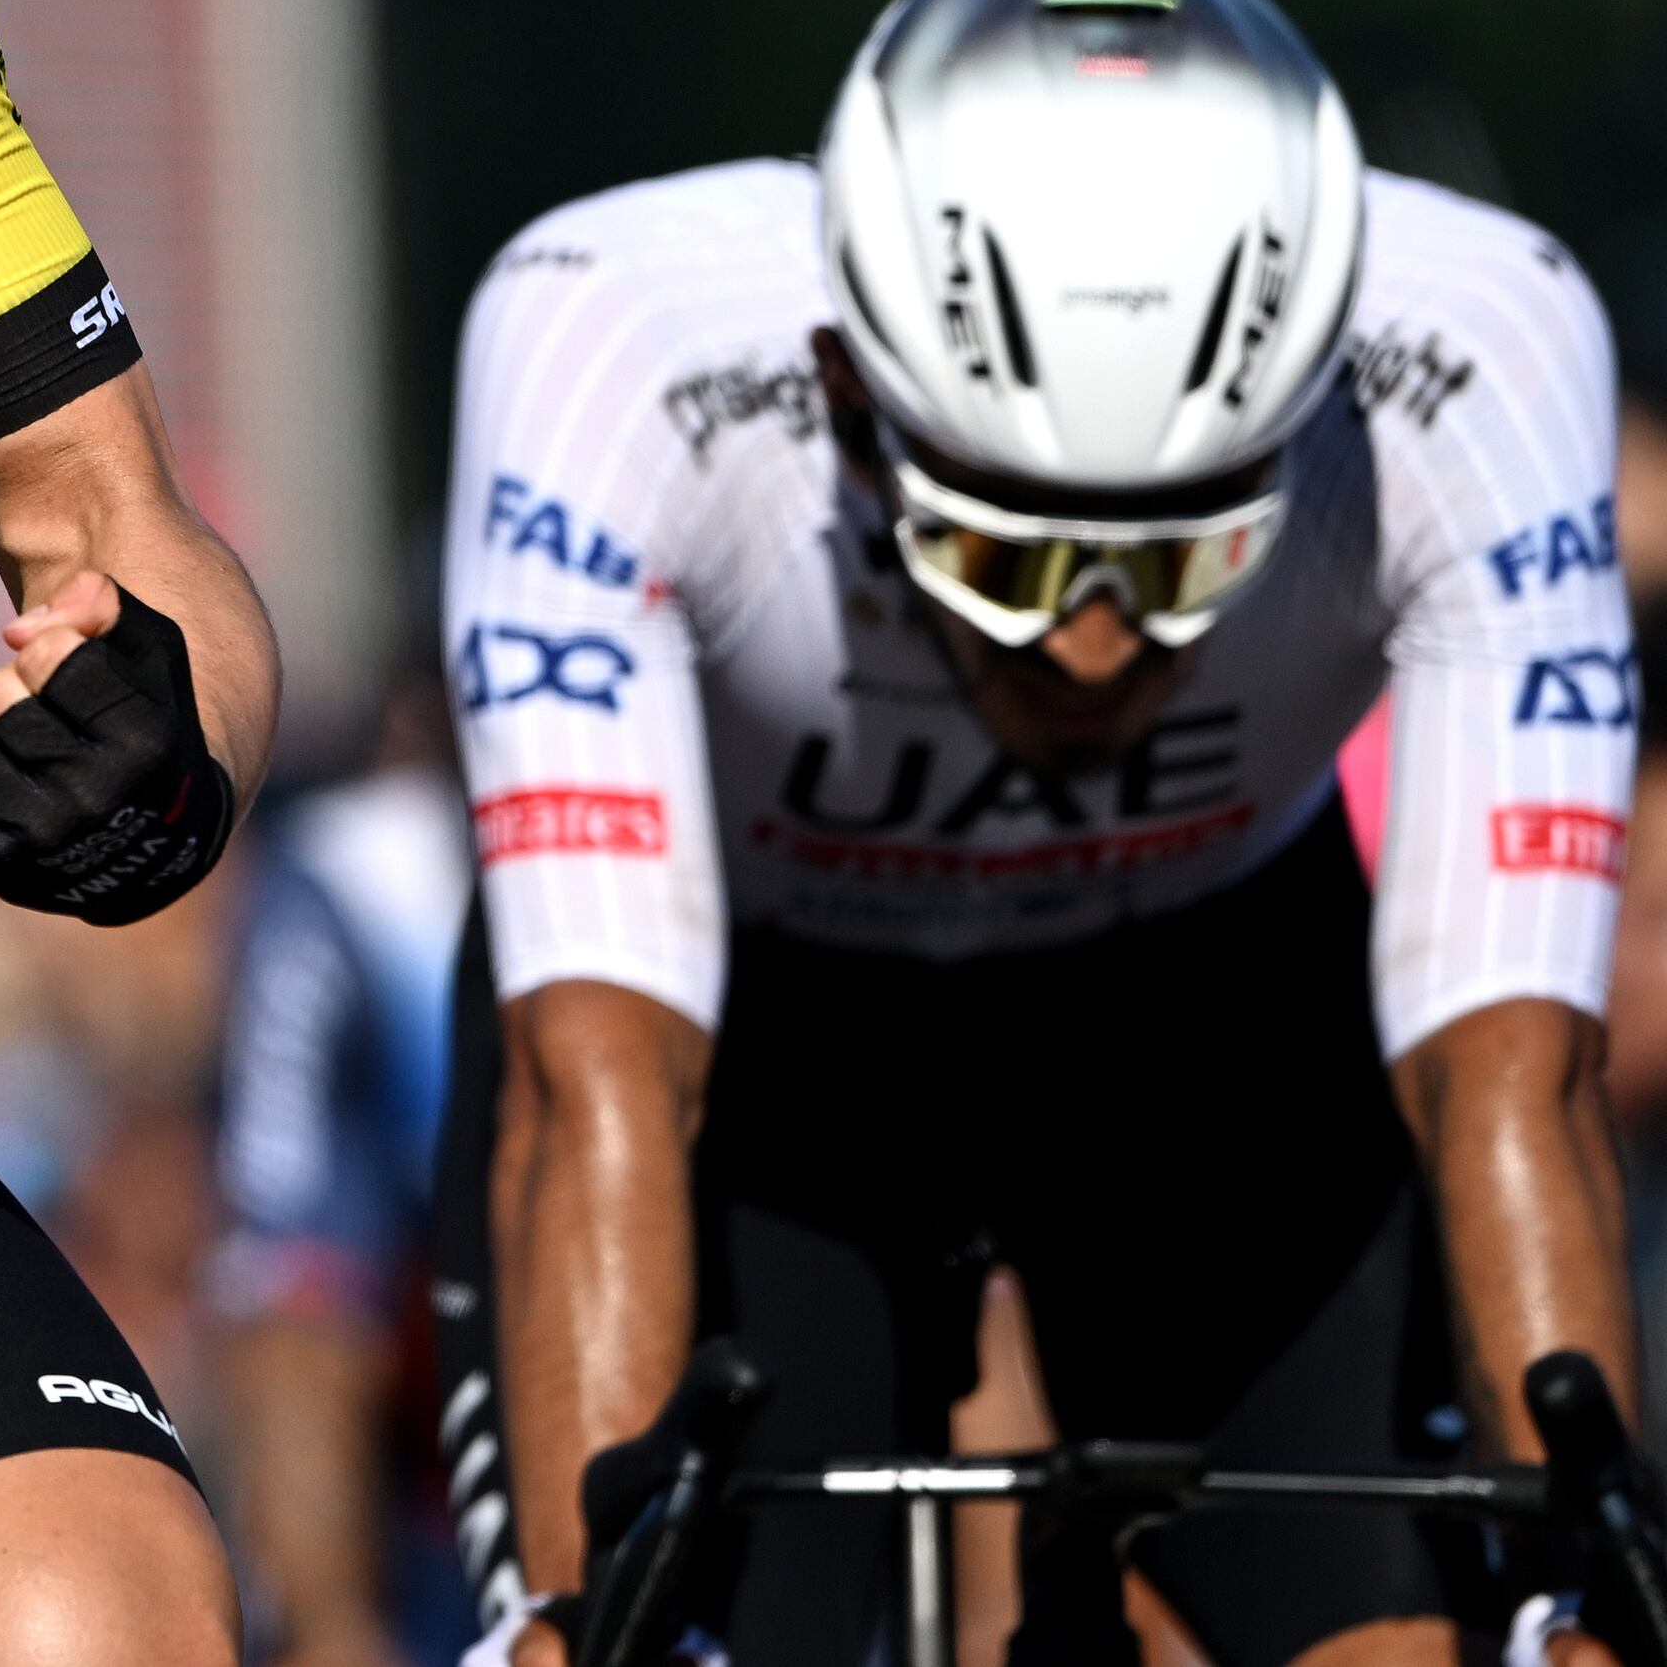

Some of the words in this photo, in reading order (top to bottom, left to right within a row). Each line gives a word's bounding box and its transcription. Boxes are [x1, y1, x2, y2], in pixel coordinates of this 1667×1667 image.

[69, 281, 126, 349] SR
[782, 704, 1241, 834] UAE
[38, 1375, 175, 1437] AGU
